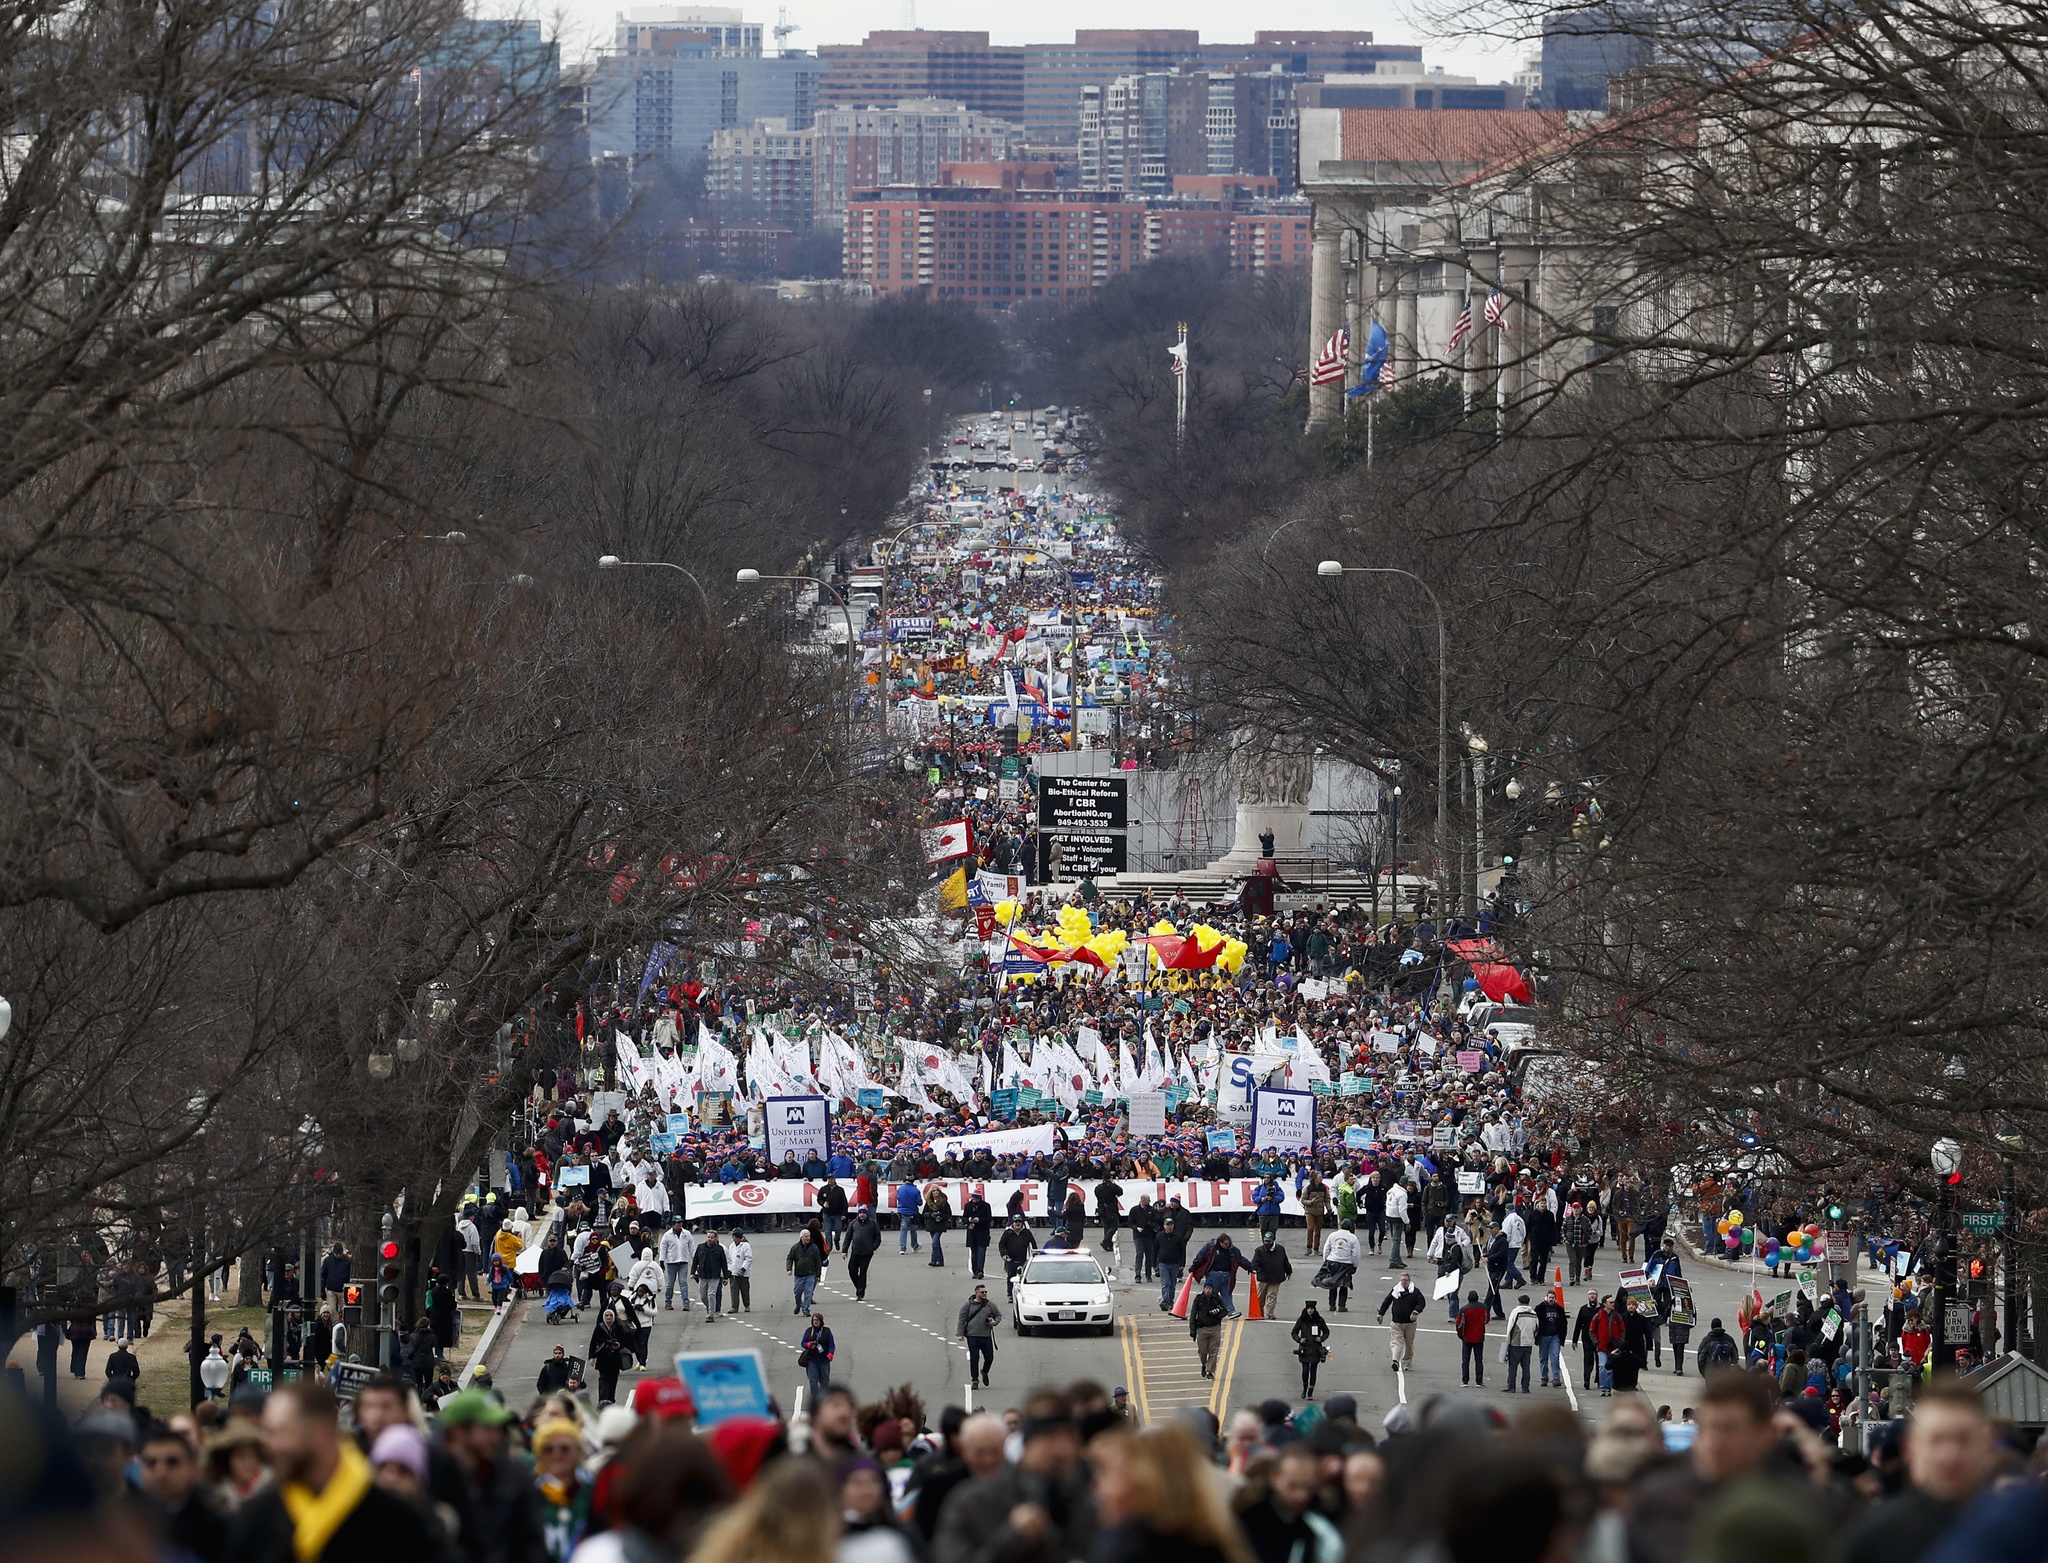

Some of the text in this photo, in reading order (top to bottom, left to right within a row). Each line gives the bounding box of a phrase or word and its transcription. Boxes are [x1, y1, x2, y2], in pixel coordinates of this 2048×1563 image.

[1073, 779, 1098, 787] Center
[1048, 788, 1119, 798] Bio-Ethical Reform
[1076, 799, 1096, 807] CBR
[1053, 809, 1113, 819] AbortionNO.org
[1058, 819, 1109, 827] 949-493-3535
[1071, 835, 1113, 844] INVOLVED:
[1260, 1118, 1310, 1129] UNIVERSITY
[772, 1128, 823, 1136] UNIVERSITY
[1268, 1127, 1303, 1138] of MARY
[780, 1137, 788, 1147] of
[964, 1139, 1005, 1147] UNIVERSITY
[1010, 1139, 1019, 1147] for
[1963, 1215, 1995, 1225] FIRST
[1974, 1227, 1995, 1235] 100
[1802, 1281, 1815, 1290] DEFEND
[1807, 1289, 1815, 1297] LIFE
